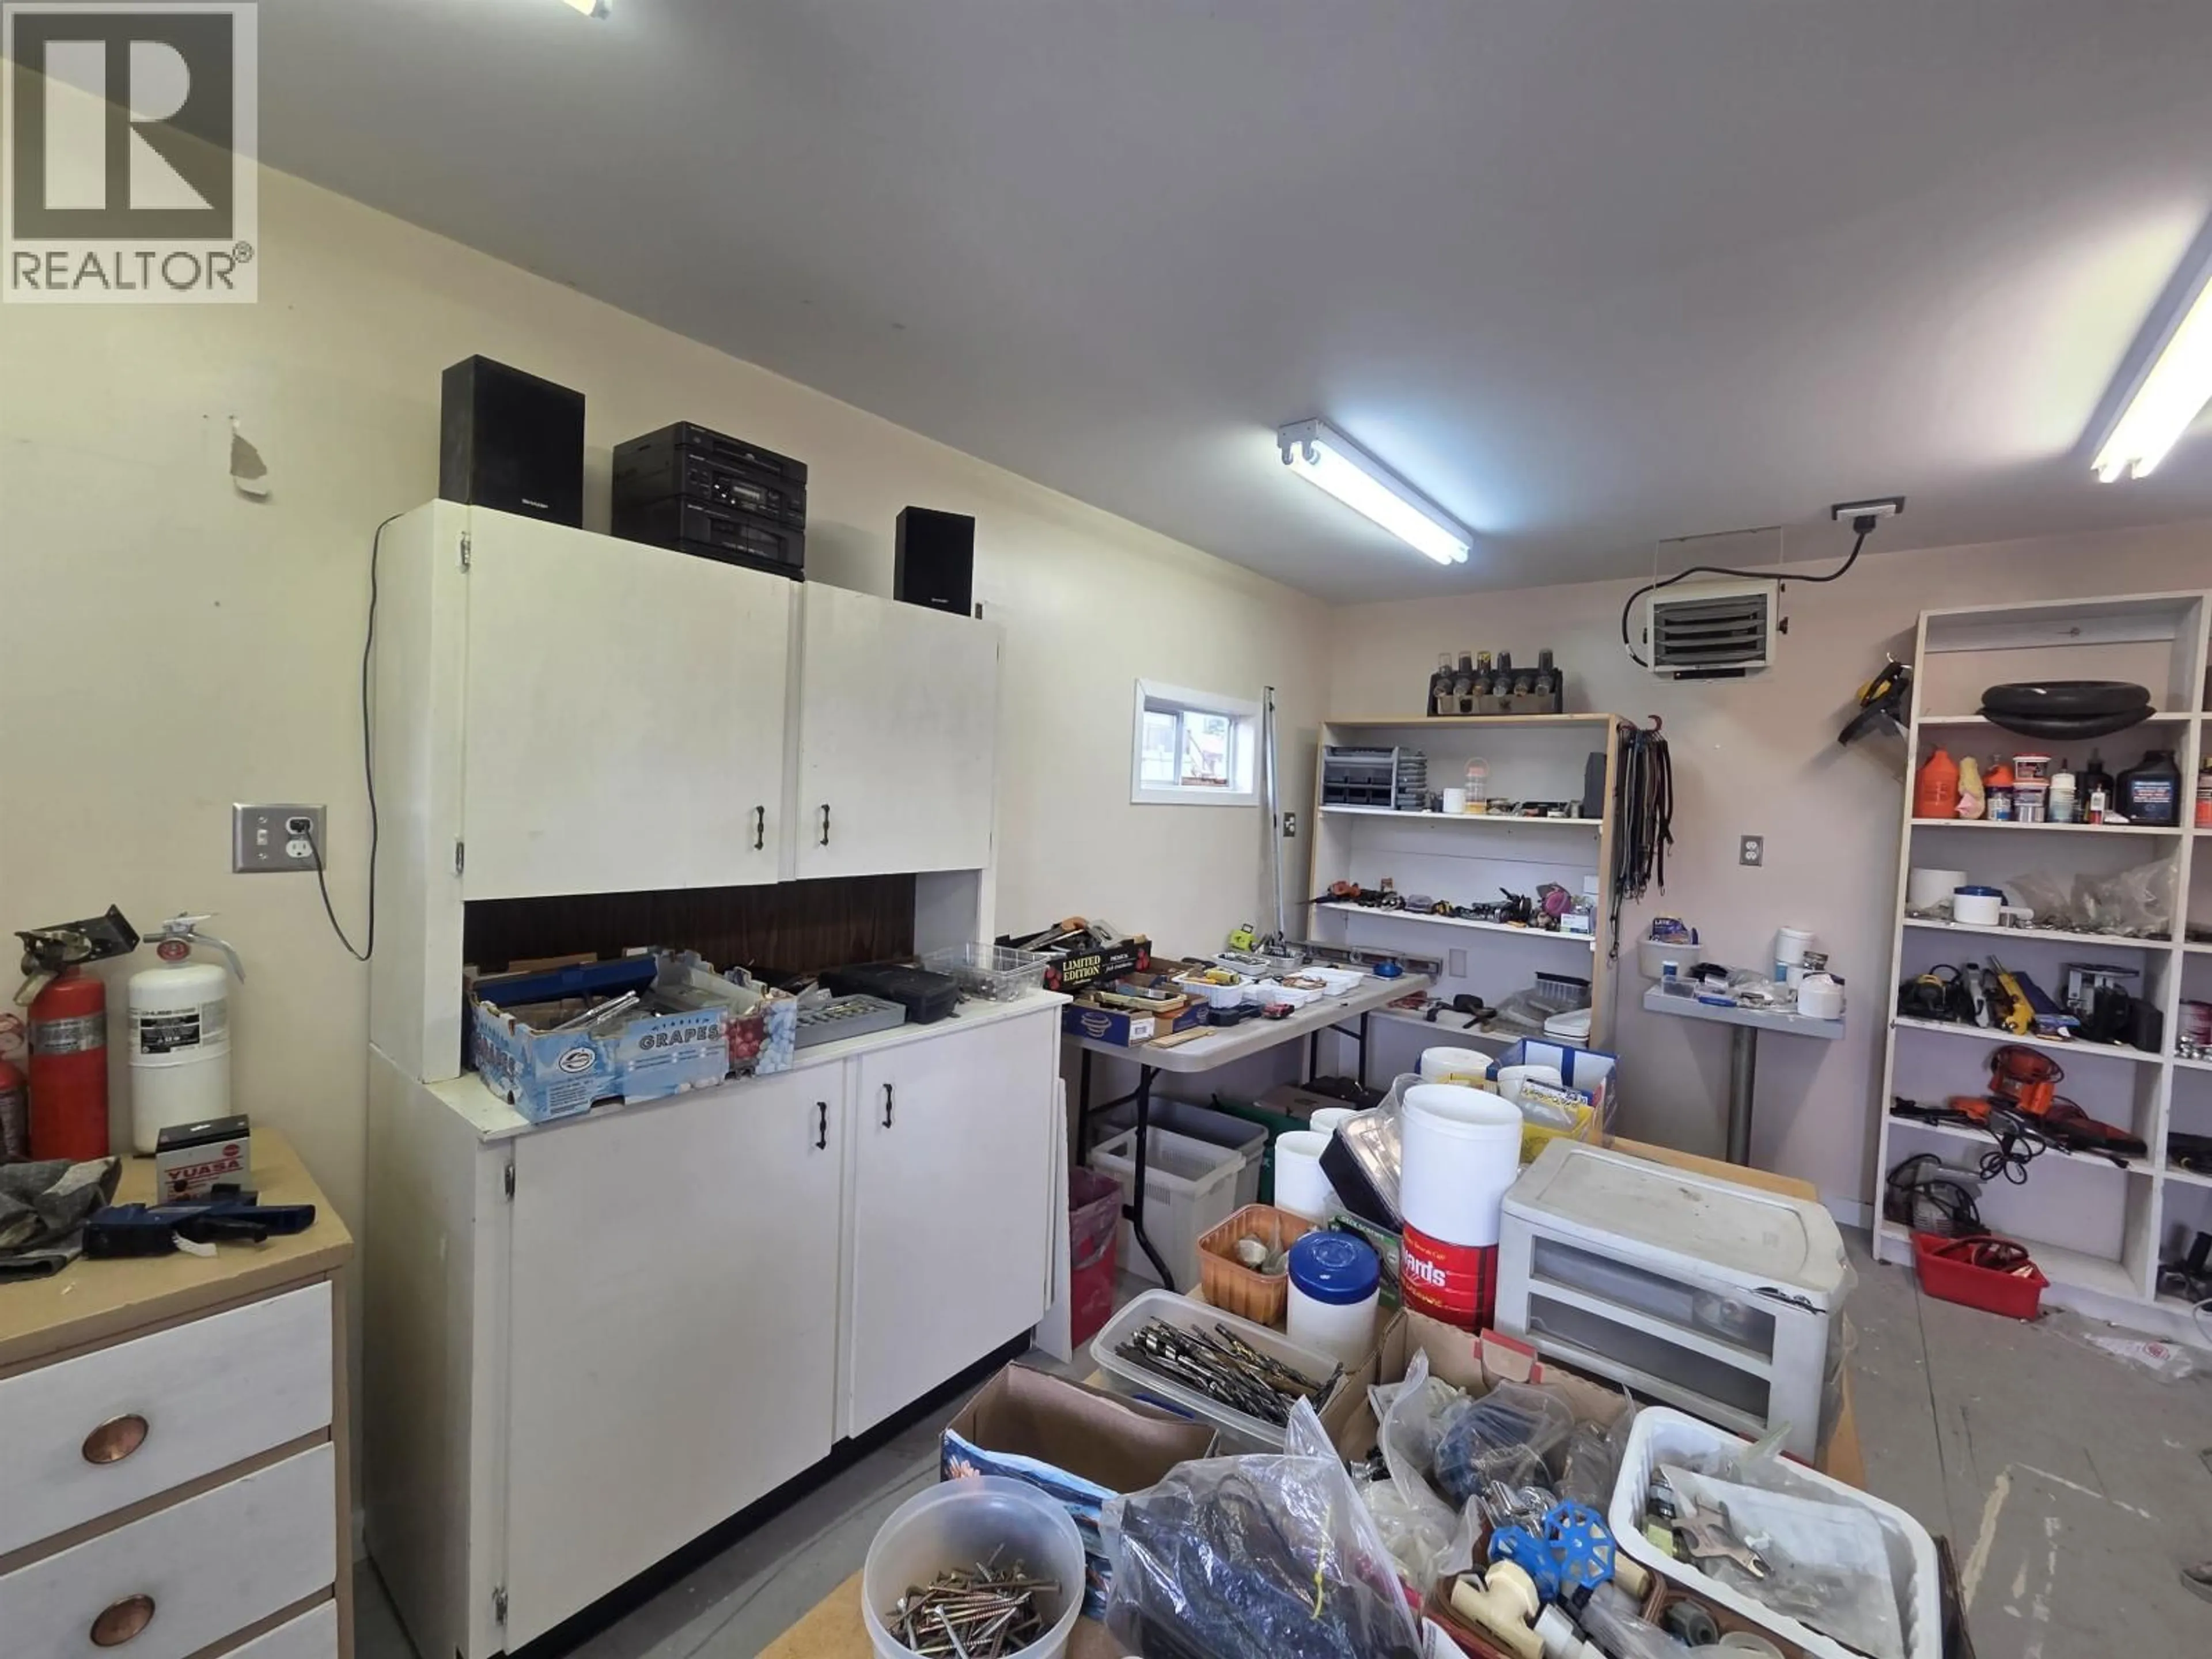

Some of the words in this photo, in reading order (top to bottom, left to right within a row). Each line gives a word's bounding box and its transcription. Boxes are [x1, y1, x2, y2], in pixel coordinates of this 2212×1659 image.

[1063, 955, 1101, 971] LIMITED
[1063, 965, 1100, 982] EDITION
[639, 1024, 721, 1050] GRAPES
[168, 1161, 240, 1179] YUASA
